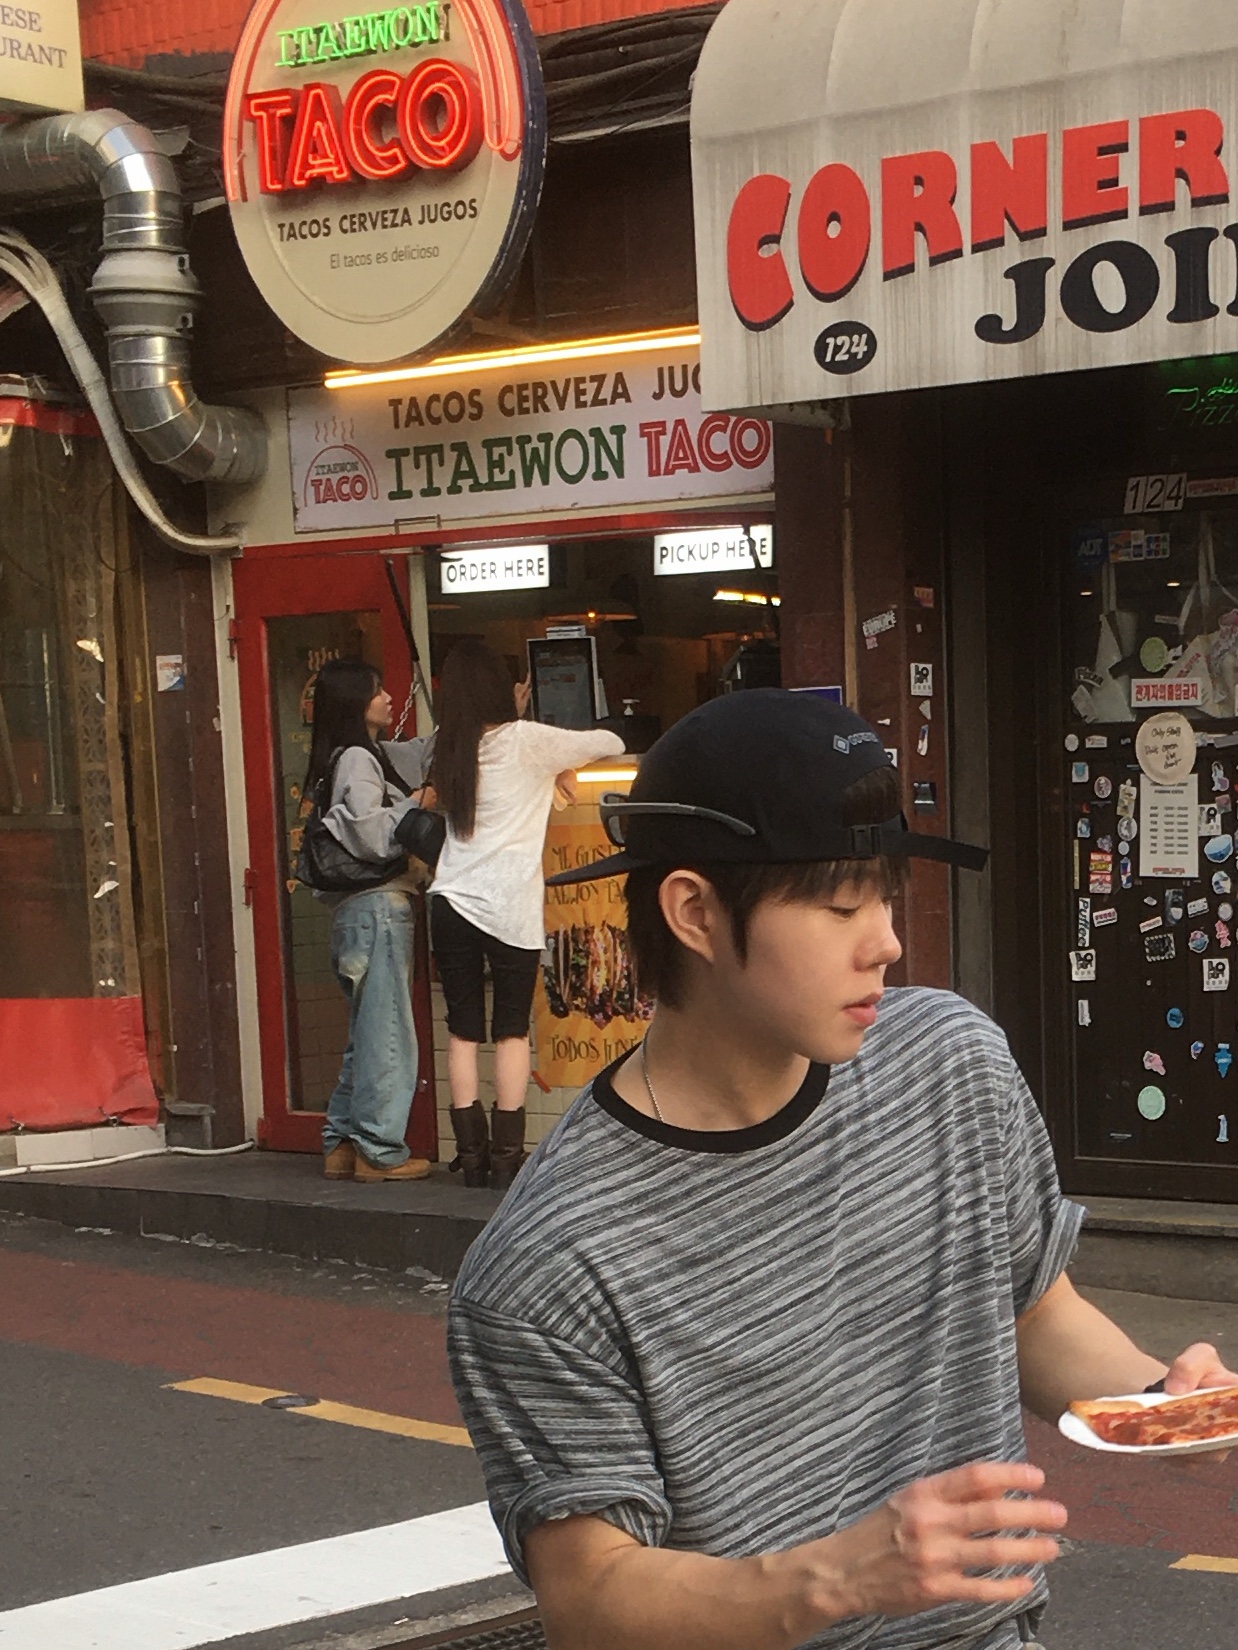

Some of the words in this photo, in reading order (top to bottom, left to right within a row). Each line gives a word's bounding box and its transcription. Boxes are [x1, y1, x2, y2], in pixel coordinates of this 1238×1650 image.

[275, 1, 441, 66] ITAEWON
[246, 58, 482, 195] TACO
[278, 218, 331, 242] TACOS
[339, 208, 412, 233] CERVEZA
[418, 198, 478, 224] JUGOS
[727, 108, 1230, 332] CORNER
[330, 253, 341, 269] El
[344, 252, 373, 267] tacos
[376, 252, 389, 264] es
[391, 245, 440, 262] delicioso
[822, 332, 870, 363] 124
[388, 388, 484, 429] TACOS
[497, 372, 632, 417] CERVEZA
[314, 460, 359, 476] ITAEWON
[385, 424, 627, 501] ITAEWON
[639, 414, 772, 478] TACO
[311, 474, 369, 505] TACO
[1130, 478, 1183, 511] 124
[446, 558, 498, 583] ORDER
[504, 556, 546, 579] HERE
[659, 541, 721, 565] PICKUP
